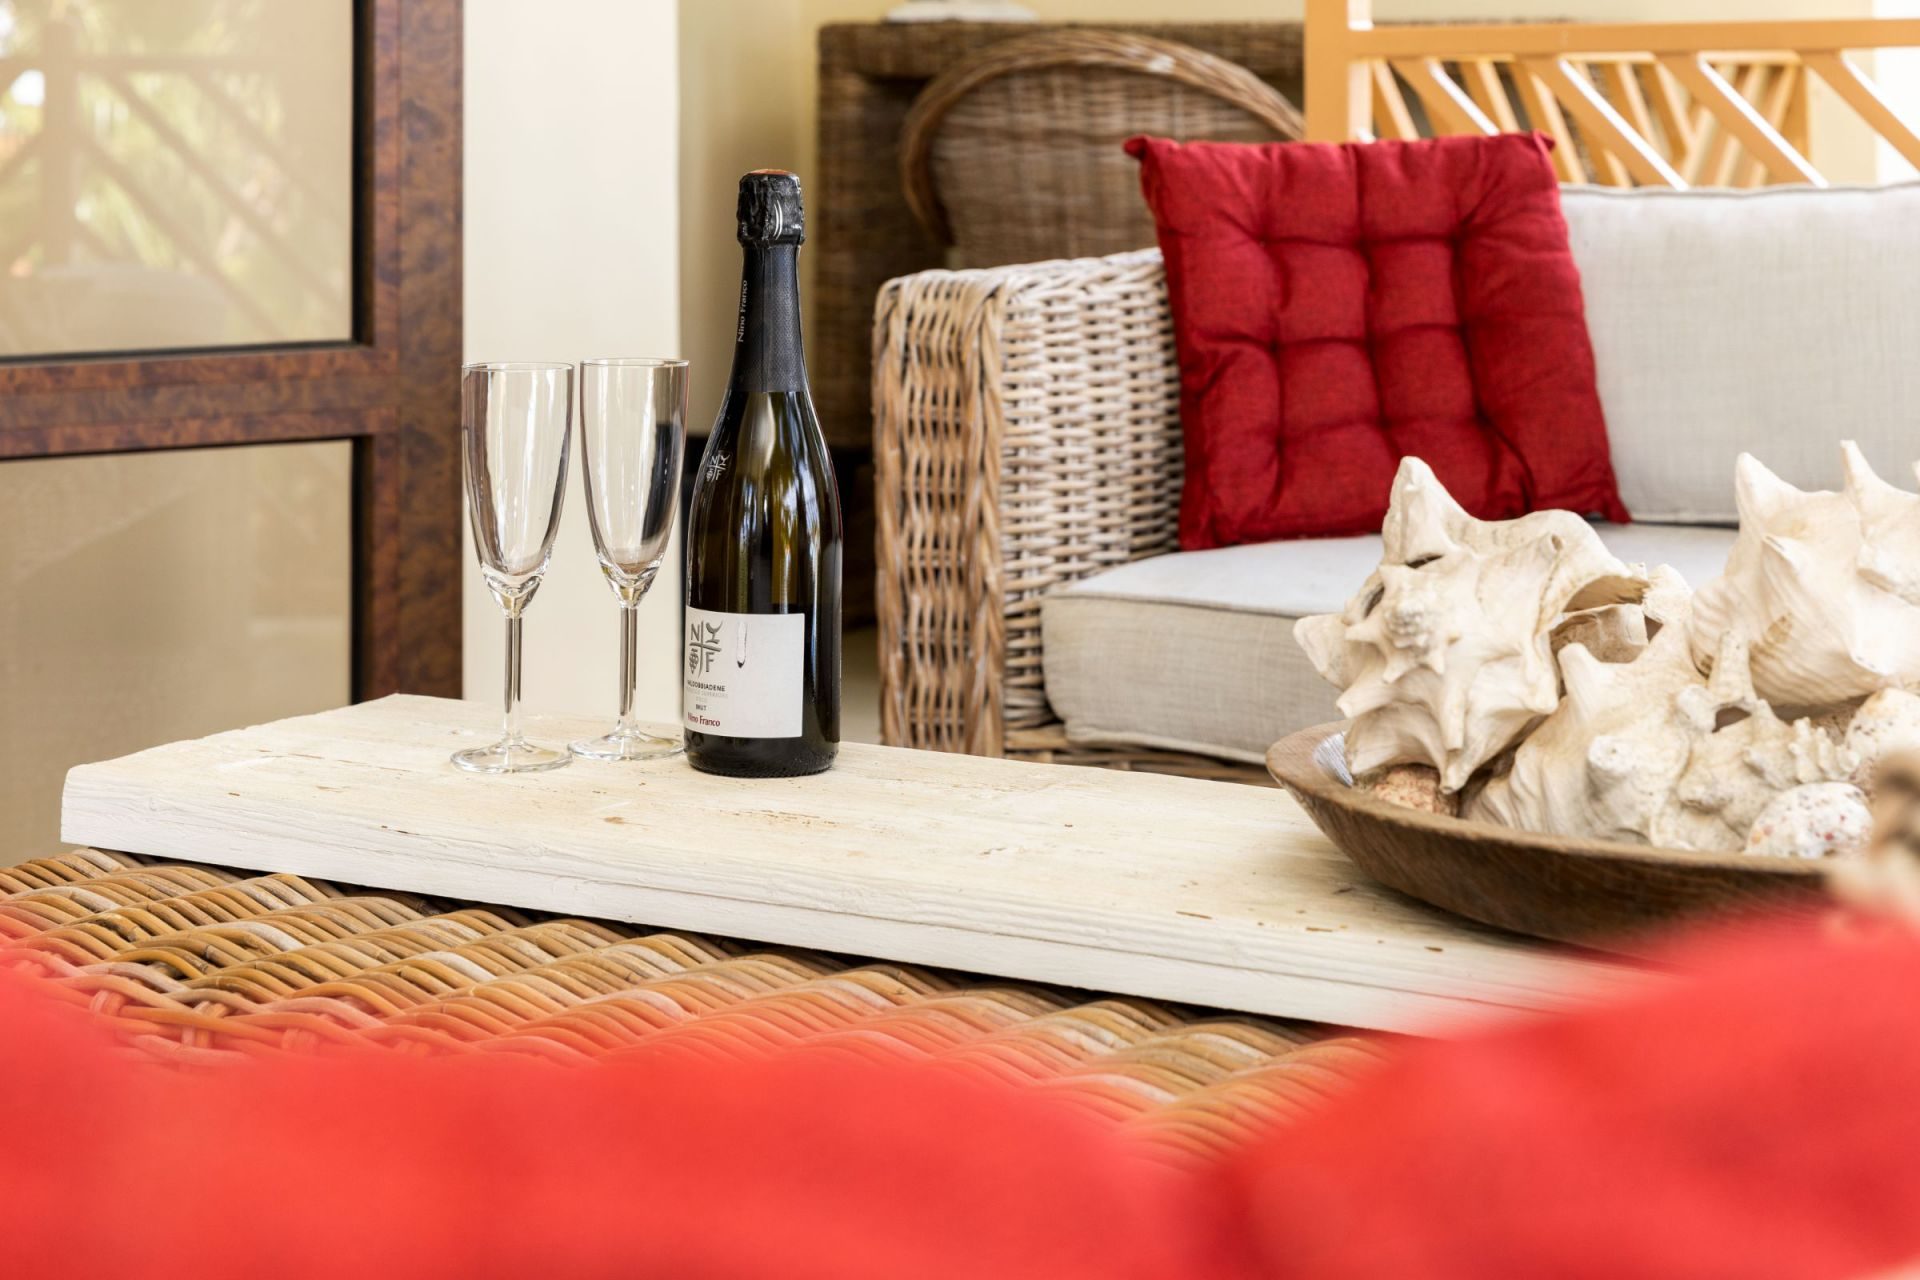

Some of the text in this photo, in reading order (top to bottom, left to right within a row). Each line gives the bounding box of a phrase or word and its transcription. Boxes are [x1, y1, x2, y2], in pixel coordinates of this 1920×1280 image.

[691, 624, 700, 641] N
[705, 652, 715, 672] F
[700, 715, 720, 726] Franco
